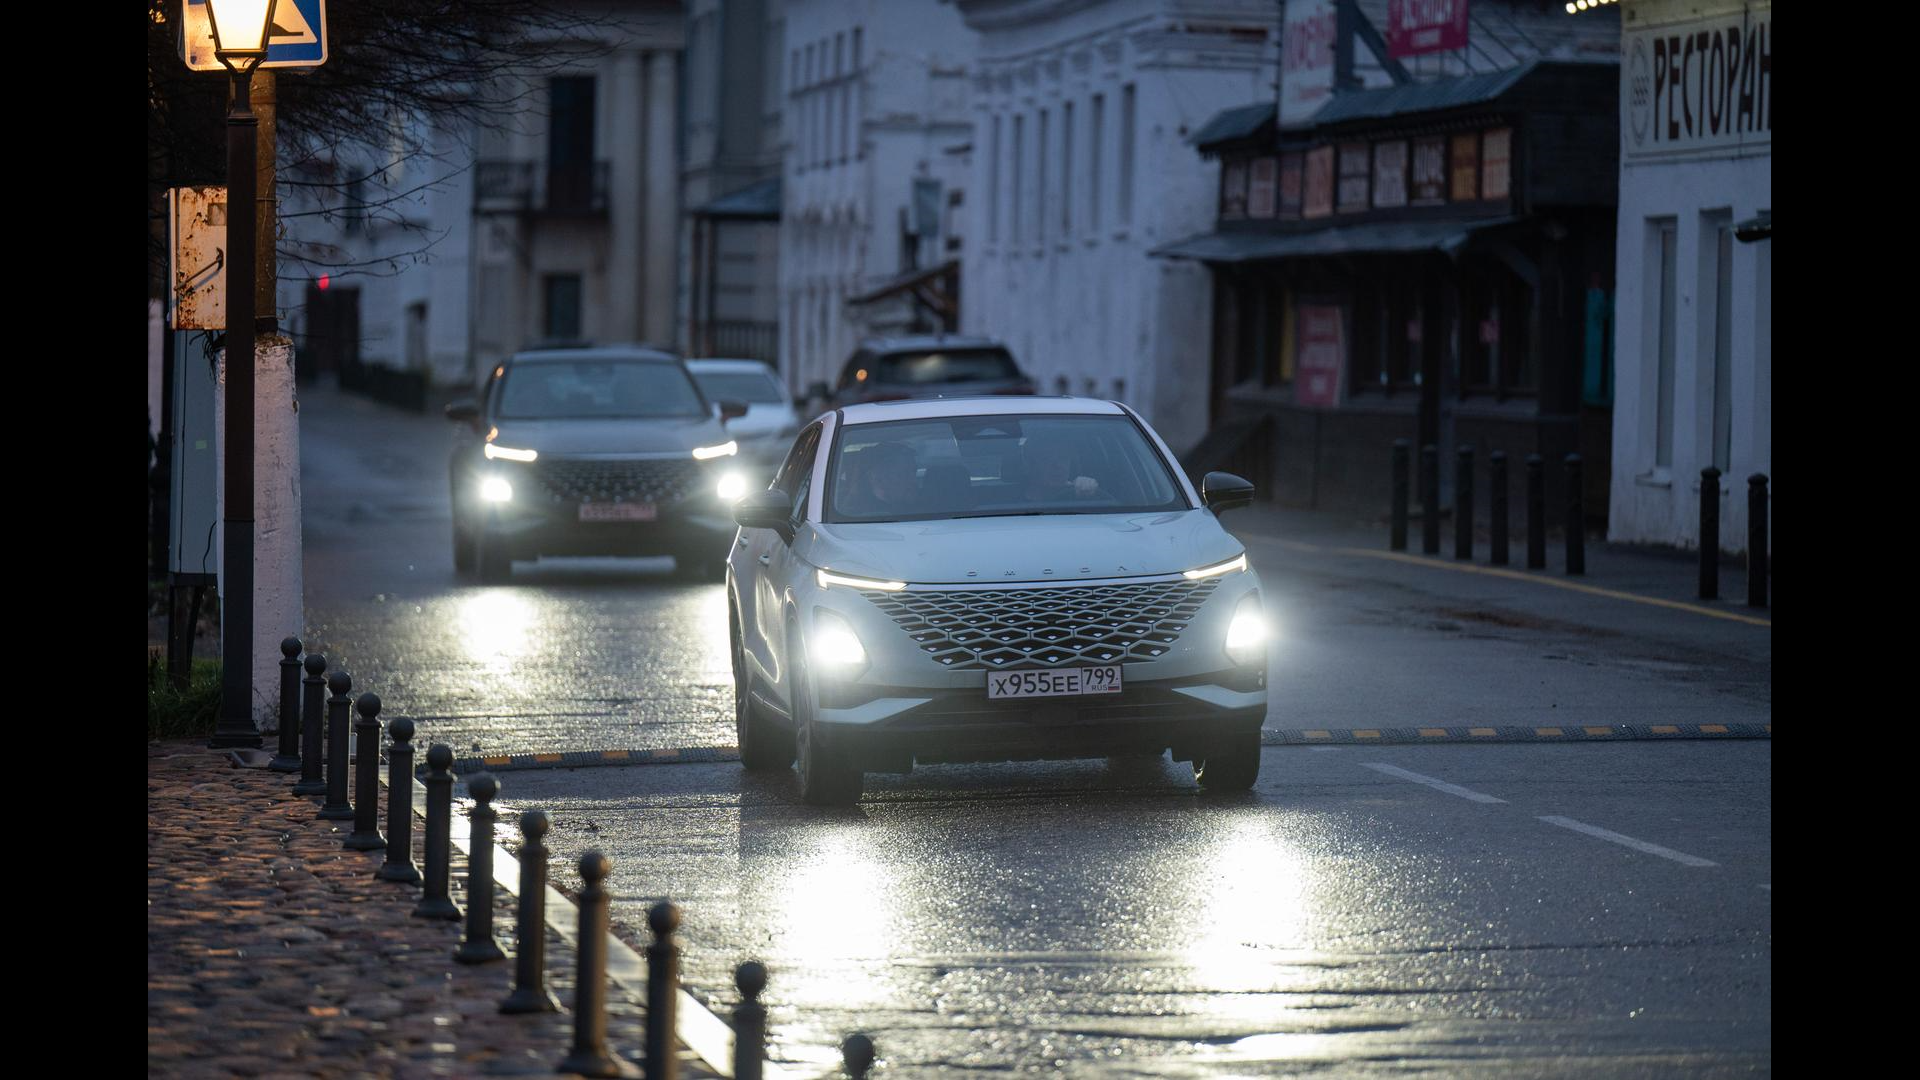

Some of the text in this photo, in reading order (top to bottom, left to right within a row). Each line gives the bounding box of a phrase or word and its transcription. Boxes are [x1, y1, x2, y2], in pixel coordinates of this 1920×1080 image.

[1653, 21, 1772, 141] РЕСТОРАН
[1083, 668, 1116, 685] 799
[1091, 684, 1108, 692] RUS
